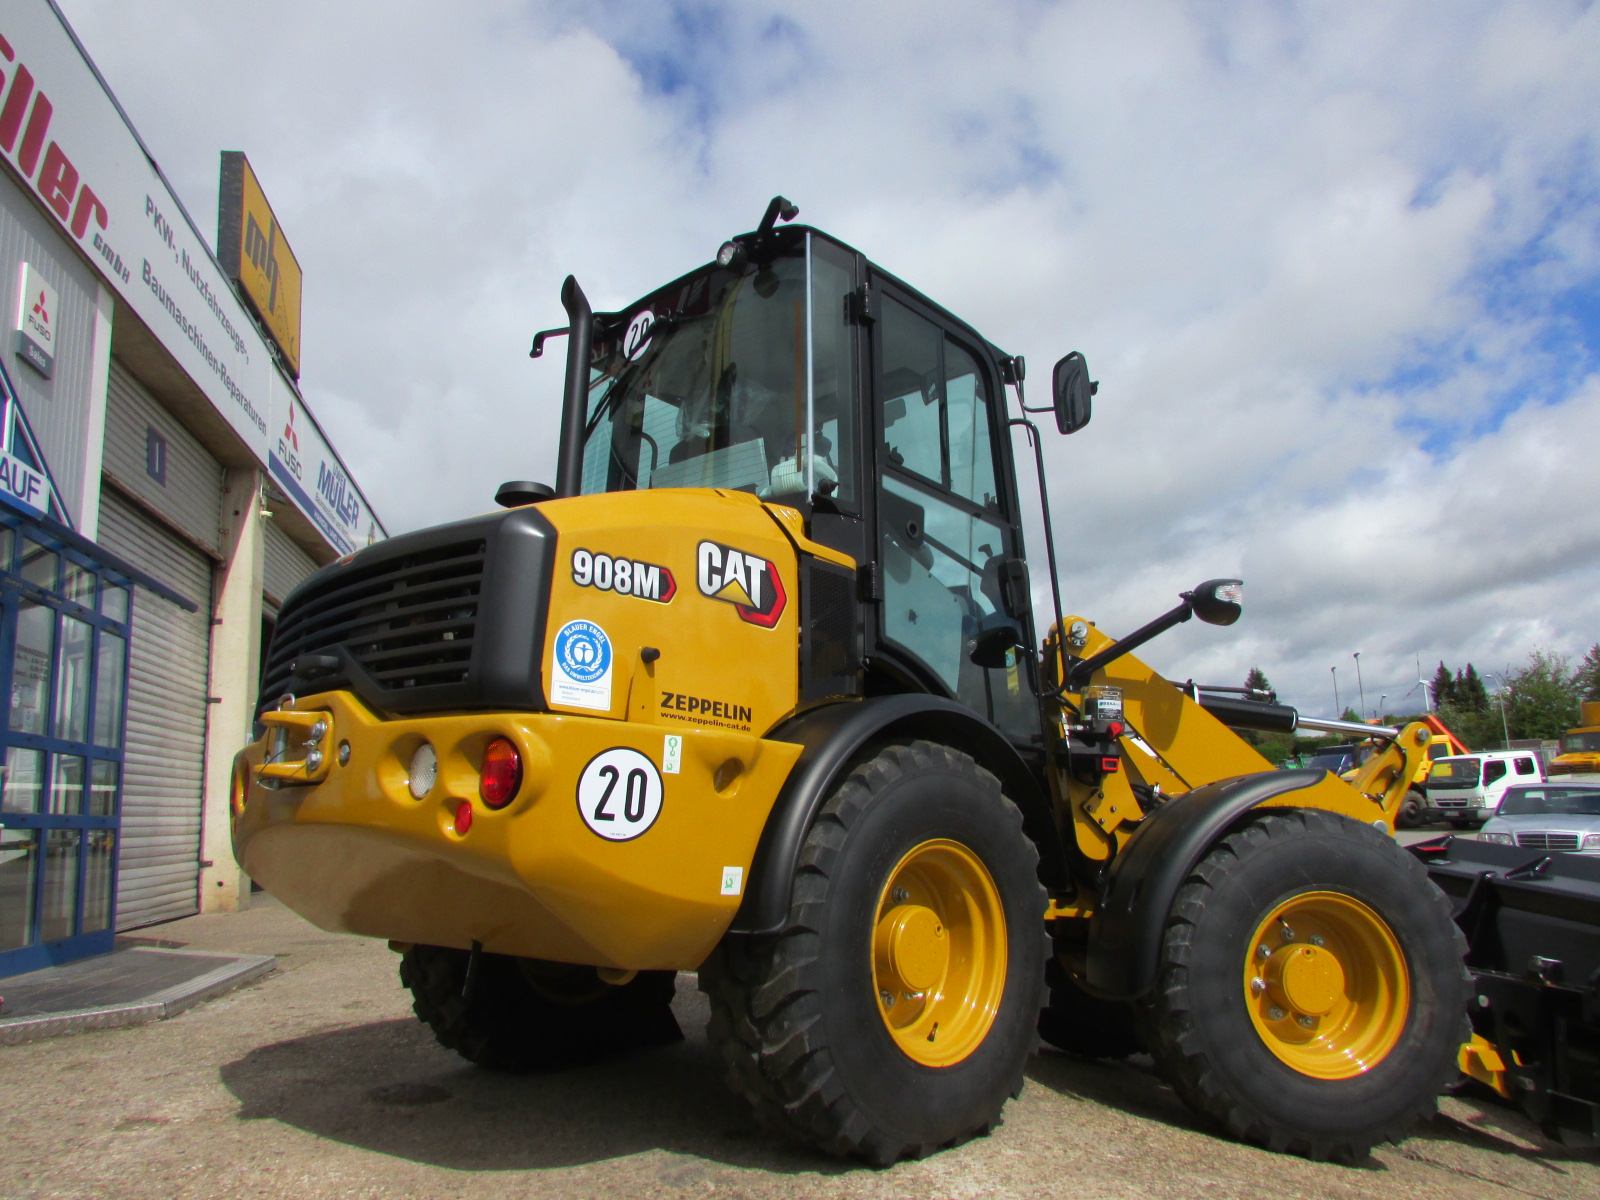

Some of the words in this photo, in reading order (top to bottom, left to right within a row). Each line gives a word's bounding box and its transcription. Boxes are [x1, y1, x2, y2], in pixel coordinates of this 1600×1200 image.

[0, 33, 108, 240] ller
[28, 314, 52, 341] FUSO
[142, 257, 268, 438] Baumaschinen-Reparaturen
[278, 436, 303, 482] FUSO
[572, 548, 661, 601] 908M
[698, 540, 767, 610] CAT
[563, 623, 588, 637] BLAUER
[588, 626, 606, 645] ENGEL
[660, 691, 752, 723] ZEPPELIN
[660, 711, 751, 732] www.zeppelin-cat.de
[594, 764, 648, 823] 20
